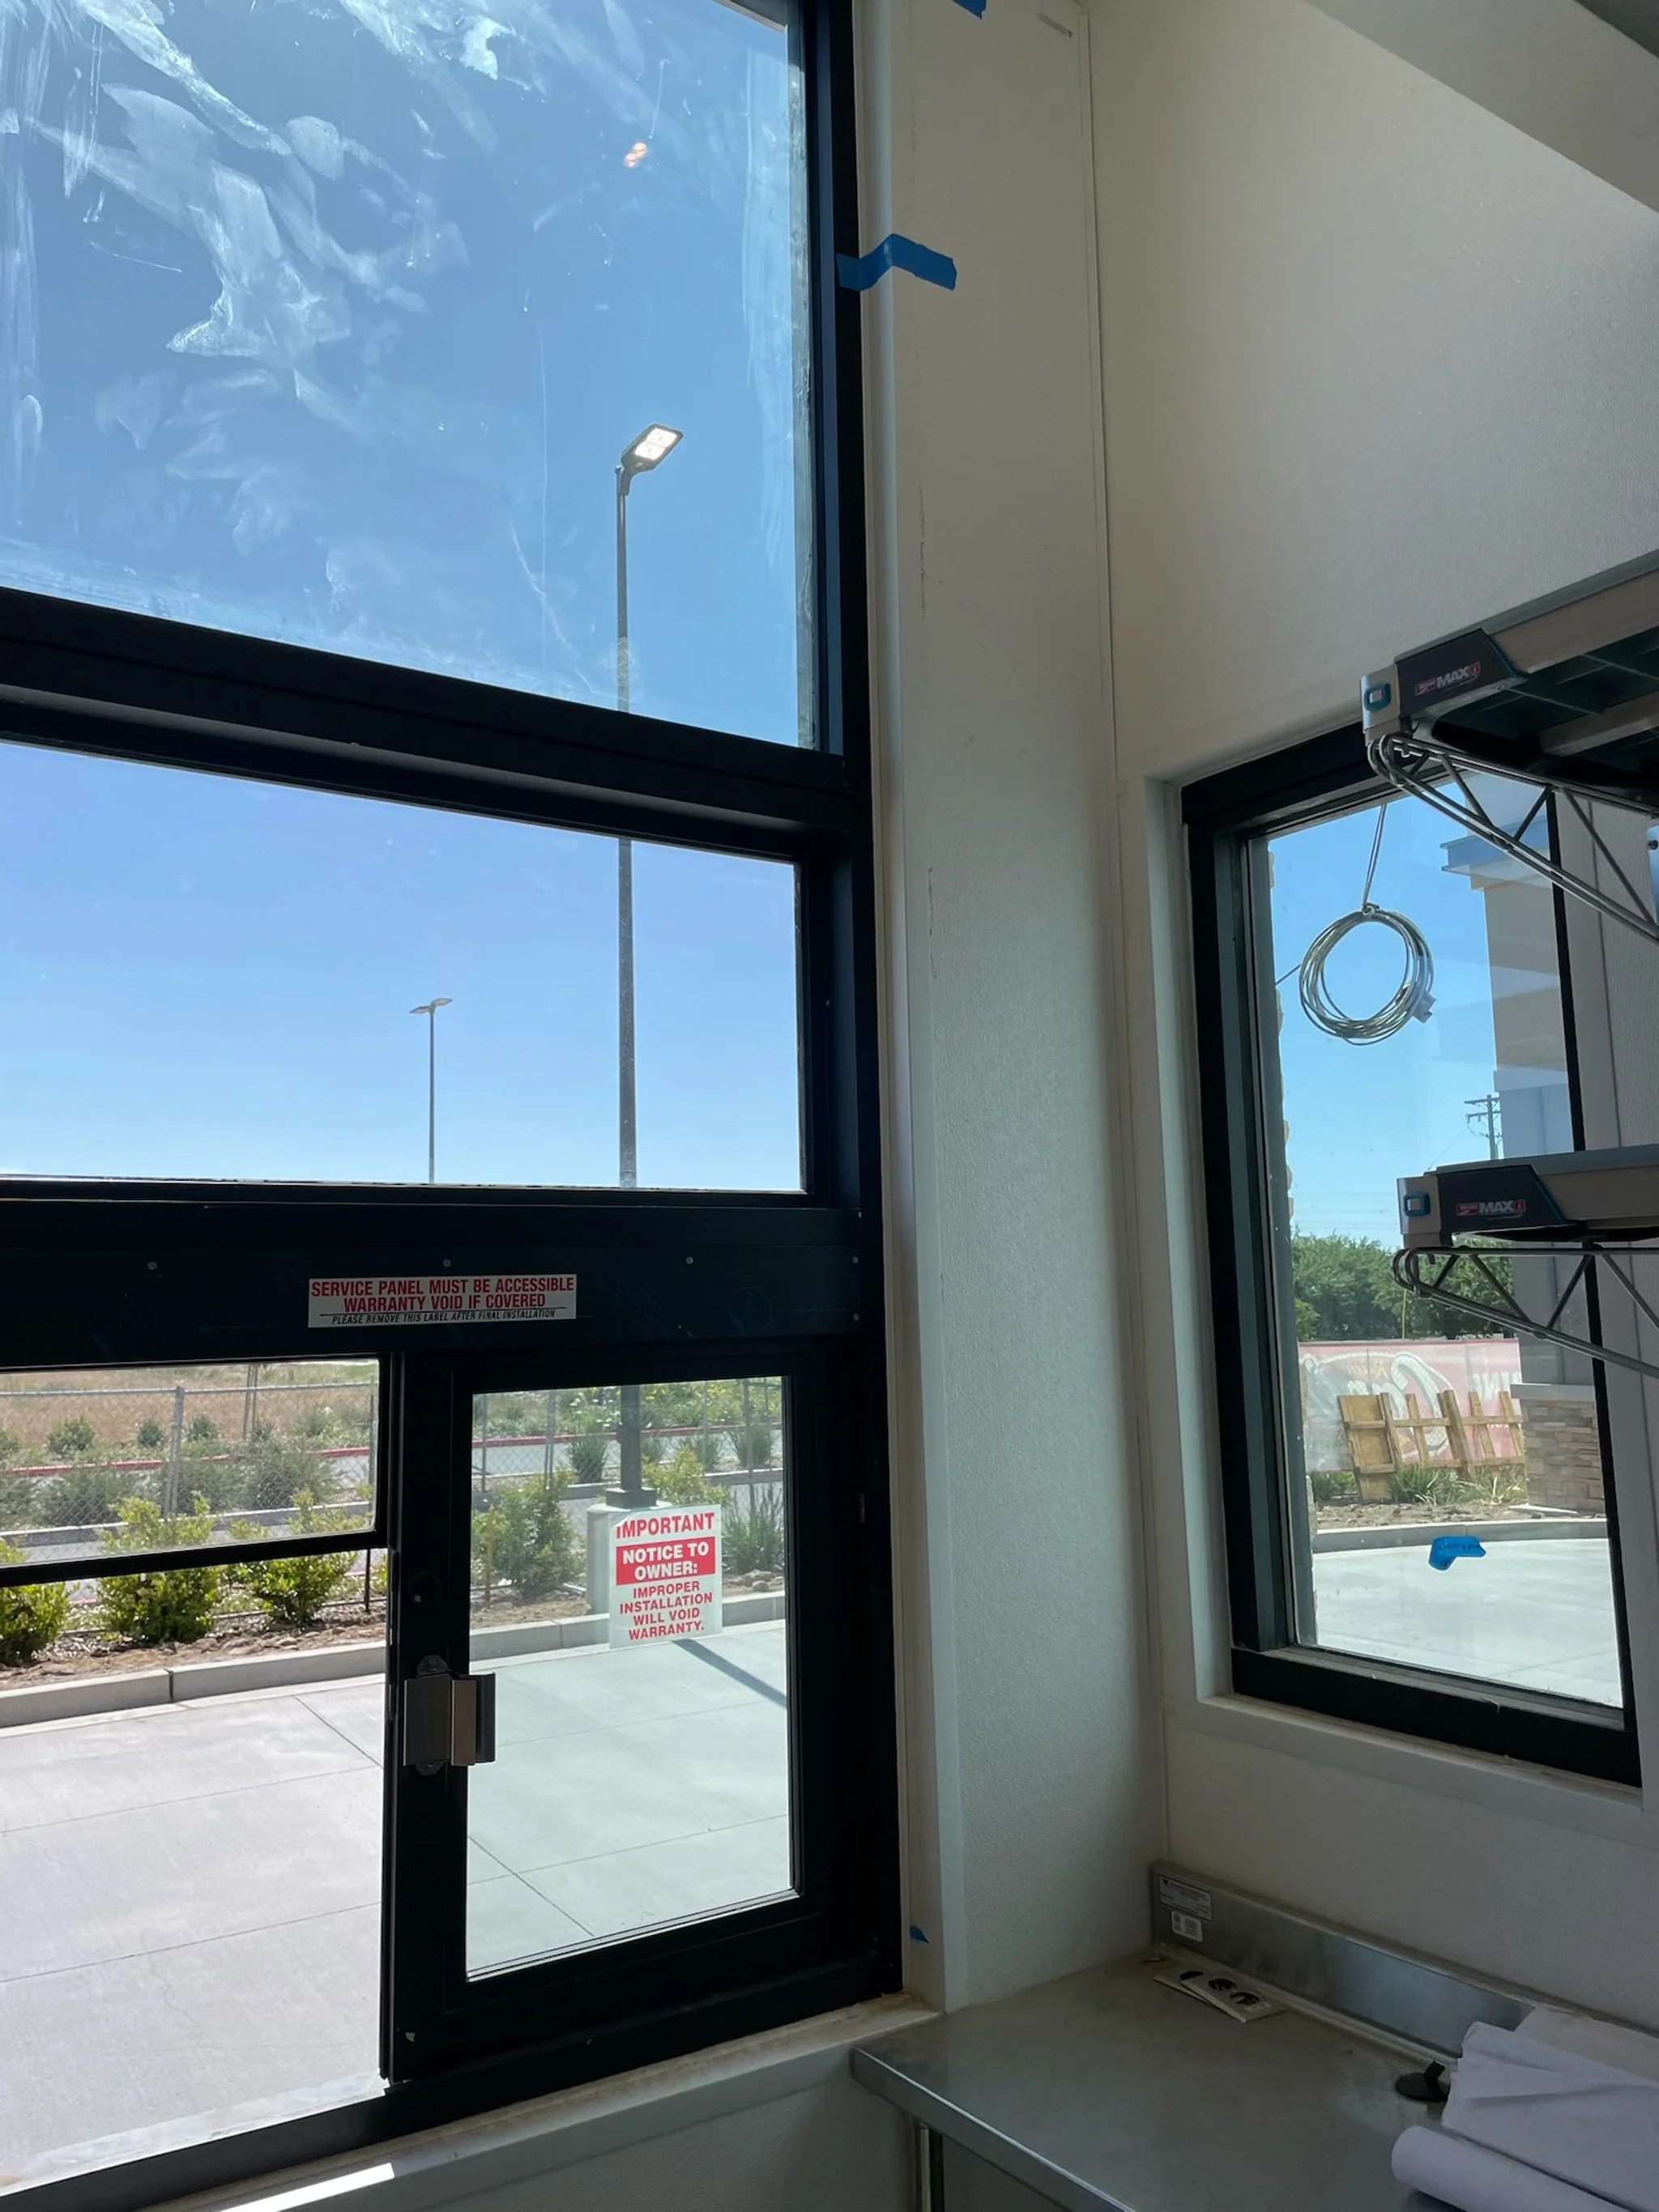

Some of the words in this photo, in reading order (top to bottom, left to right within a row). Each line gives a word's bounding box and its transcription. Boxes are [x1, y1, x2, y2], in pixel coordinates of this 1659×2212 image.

[1478, 1200, 1515, 1216] MAX
[310, 1281, 373, 1297] SERVICE
[378, 1280, 424, 1295] PANEL
[429, 1278, 469, 1294] MUST
[473, 1278, 491, 1294] BE
[495, 1277, 574, 1293] ACCESSIBLE
[343, 1296, 426, 1312] WARRANTY
[431, 1295, 463, 1311] VOID
[468, 1294, 481, 1309] IF
[485, 1294, 546, 1308] COVERED
[331, 1315, 364, 1324] PLEASE
[365, 1314, 400, 1323] REMOVE
[403, 1313, 422, 1323] THIS
[424, 1313, 448, 1322] LABEL
[451, 1311, 476, 1321] AFTER
[478, 1311, 501, 1320] FINAL
[502, 1309, 556, 1319] INSTALLATION
[616, 1512, 714, 1539] IMPORTANT
[622, 1544, 683, 1565] NOTICE
[687, 1541, 710, 1557] TO
[634, 1561, 698, 1581] OWNER:
[633, 1580, 700, 1599] IMPROPER
[620, 1592, 713, 1614] INSTALLATION
[633, 1612, 665, 1626] WILL
[669, 1607, 700, 1621] VOID
[629, 1620, 705, 1641] WARRANTY.
